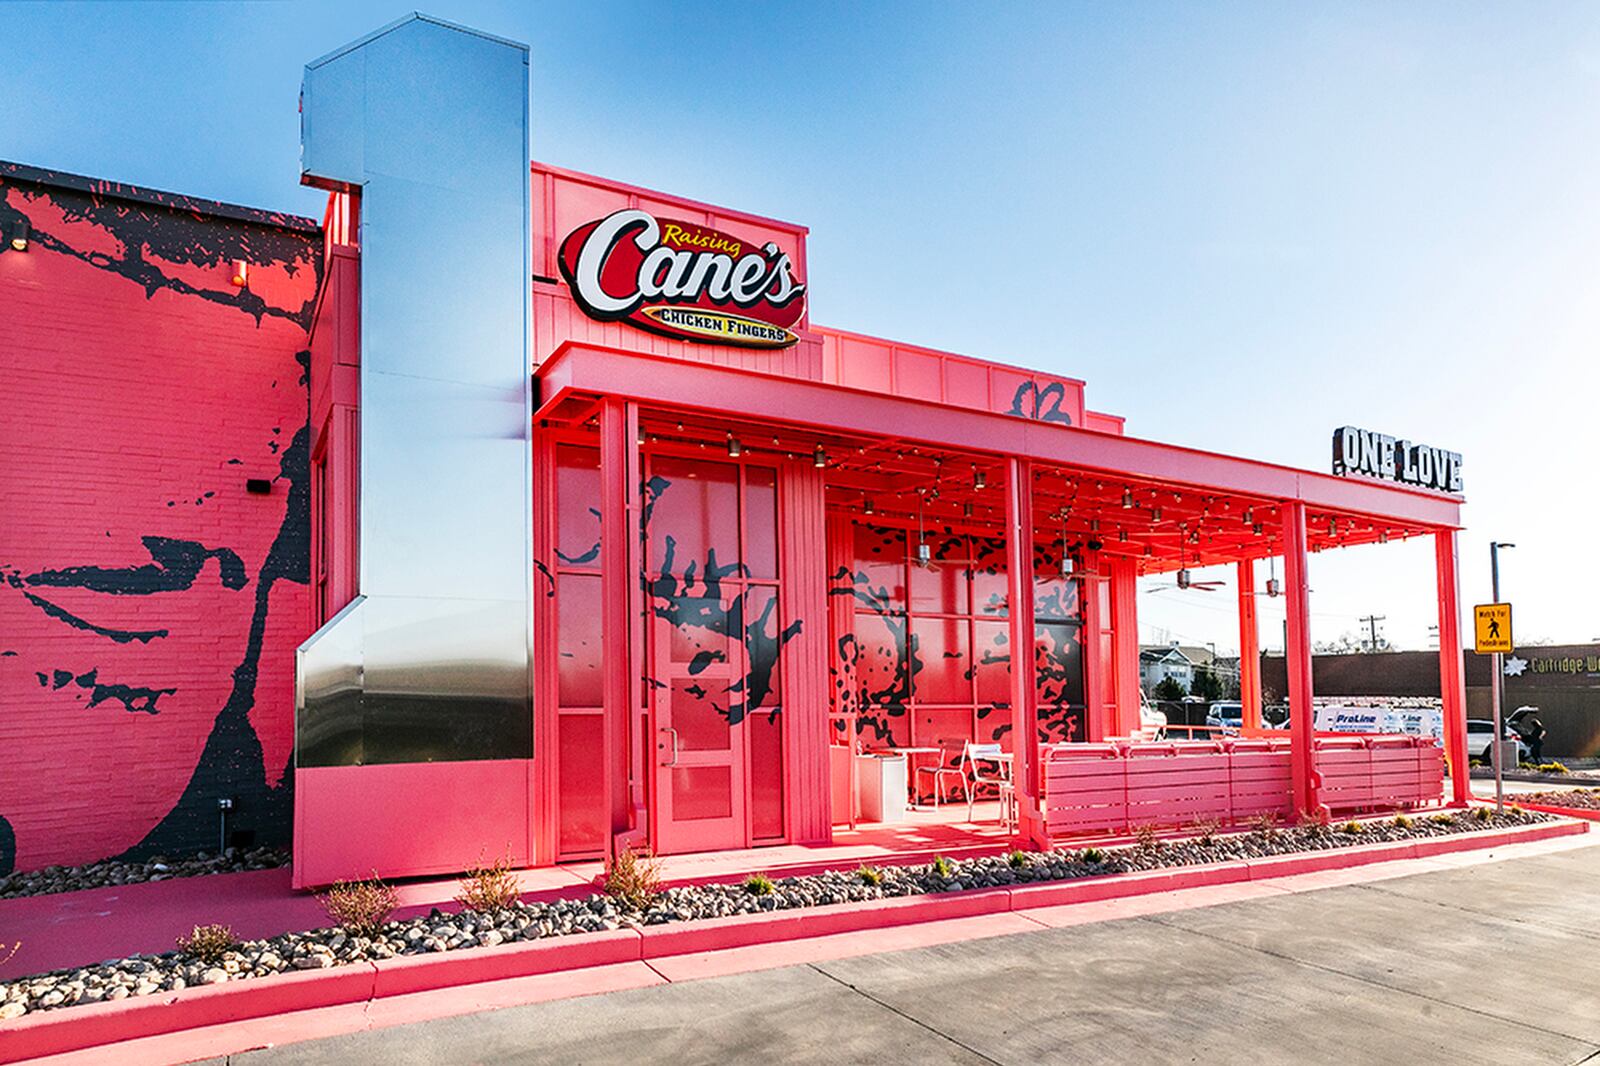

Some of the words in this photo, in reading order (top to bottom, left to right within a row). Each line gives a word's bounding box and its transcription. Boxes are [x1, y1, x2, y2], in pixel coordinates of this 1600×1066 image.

[661, 223, 742, 259] Raising
[576, 208, 806, 312] Cane's
[660, 308, 723, 332] CHICKEN
[727, 319, 786, 342] FINGERS
[1341, 425, 1396, 478] ONE
[1401, 439, 1464, 492] LOVE
[1531, 656, 1584, 675] Cartridge
[1336, 714, 1377, 723] ProLine
